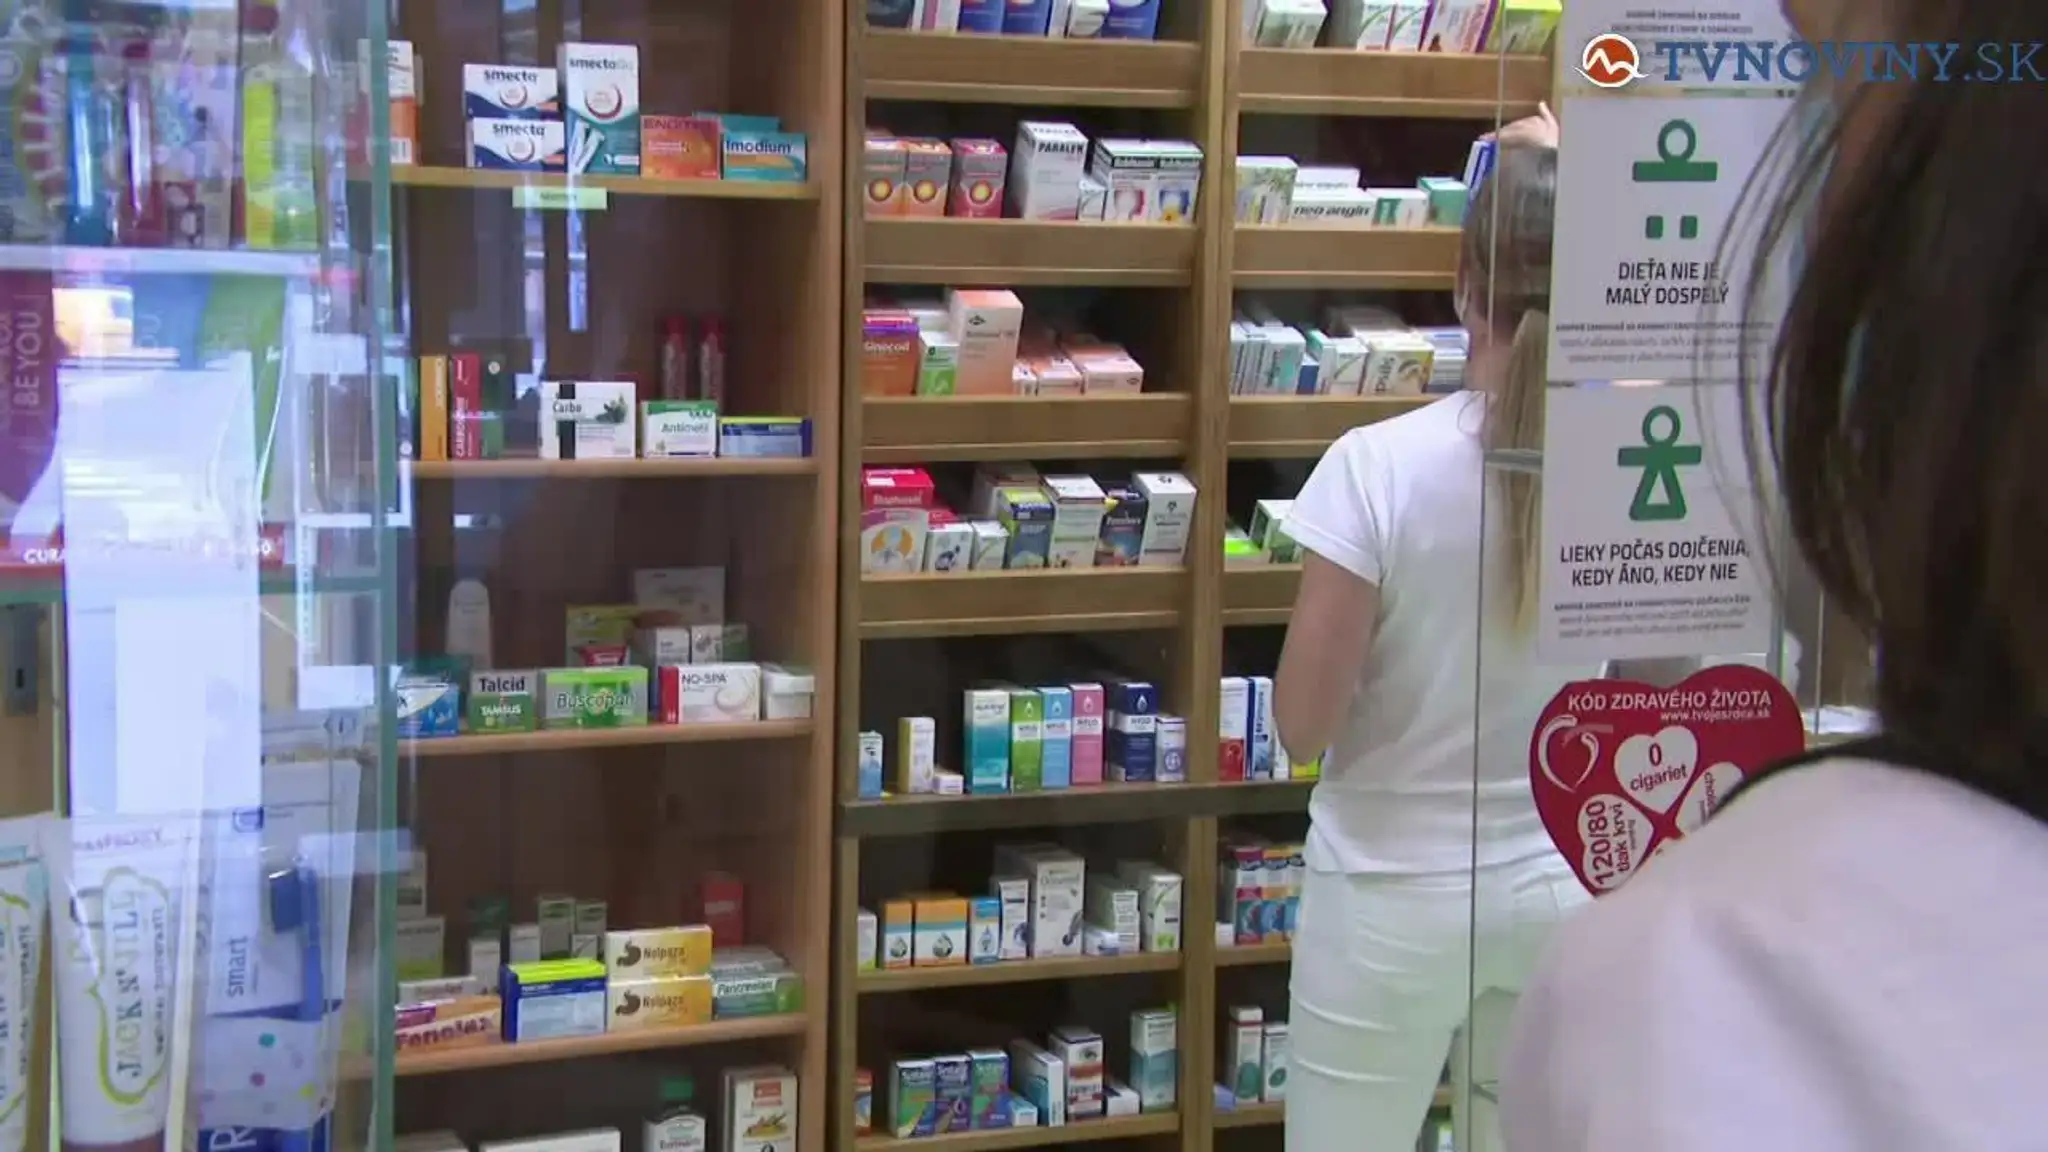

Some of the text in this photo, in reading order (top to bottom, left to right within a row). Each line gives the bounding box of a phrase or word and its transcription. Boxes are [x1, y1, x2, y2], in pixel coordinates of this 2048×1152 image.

[484, 69, 538, 83] smecta
[493, 123, 546, 137] smecta
[725, 138, 793, 154] Imodium
[1294, 205, 1325, 216] neo
[1618, 258, 1666, 281] DIEŤA
[1671, 262, 1700, 281] NIE
[1605, 282, 1730, 305] MALÝ DOSPELÝ
[552, 401, 582, 414] Carbo
[1560, 535, 1750, 563] LIEKY POČAS DOJČENIA,
[1572, 568, 1614, 587] KEDY
[1663, 564, 1706, 583] KEDY
[1710, 562, 1738, 580] NIE
[479, 676, 526, 693] Talcid
[681, 673, 727, 685] NO-SPA
[1568, 688, 1773, 711] KÓD ZDRAVÉHO ŽIVOTA
[1649, 743, 1662, 767] 0
[1629, 762, 1688, 792] cigariet
[1609, 802, 1627, 837] krvi
[643, 947, 687, 961] Nolpaza
[227, 936, 249, 998] smart
[642, 995, 685, 1009] Nolpaza
